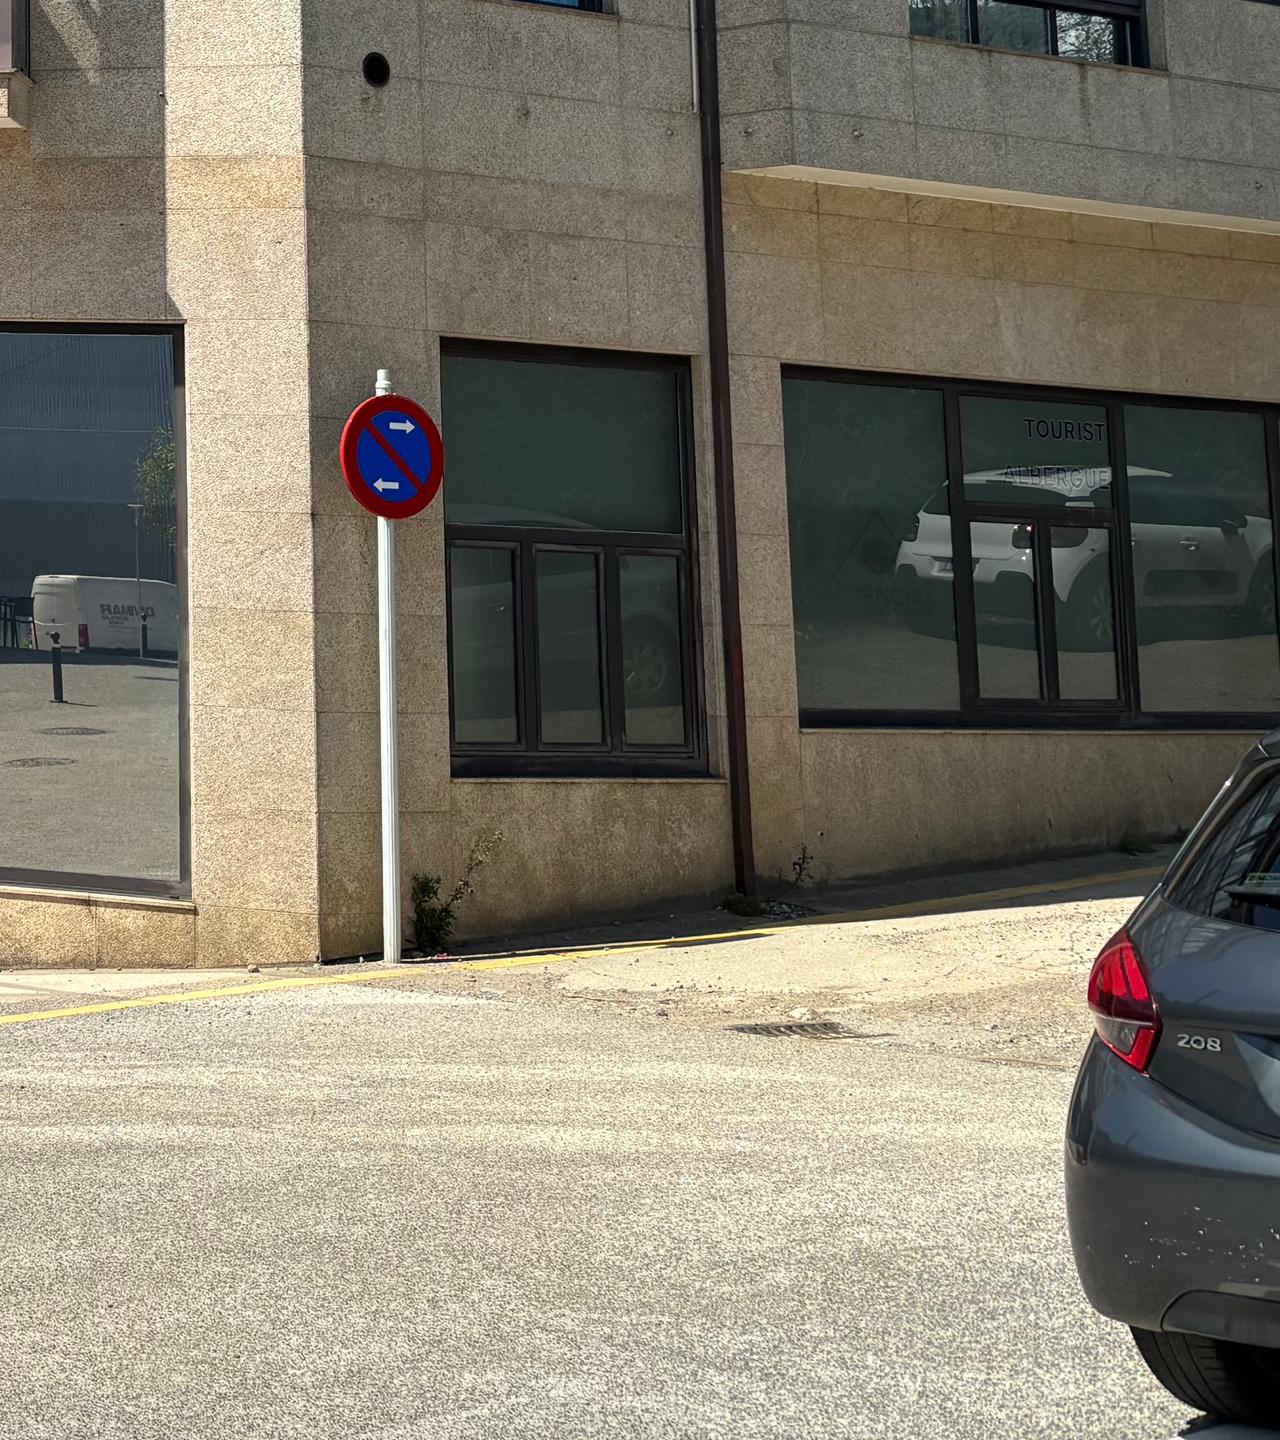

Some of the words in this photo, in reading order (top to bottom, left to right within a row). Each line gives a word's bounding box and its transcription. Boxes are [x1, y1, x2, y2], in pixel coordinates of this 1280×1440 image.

[1023, 418, 1106, 442] TOURIST
[1002, 464, 1110, 490] ALBERGUE
[1177, 1033, 1222, 1052] 208
